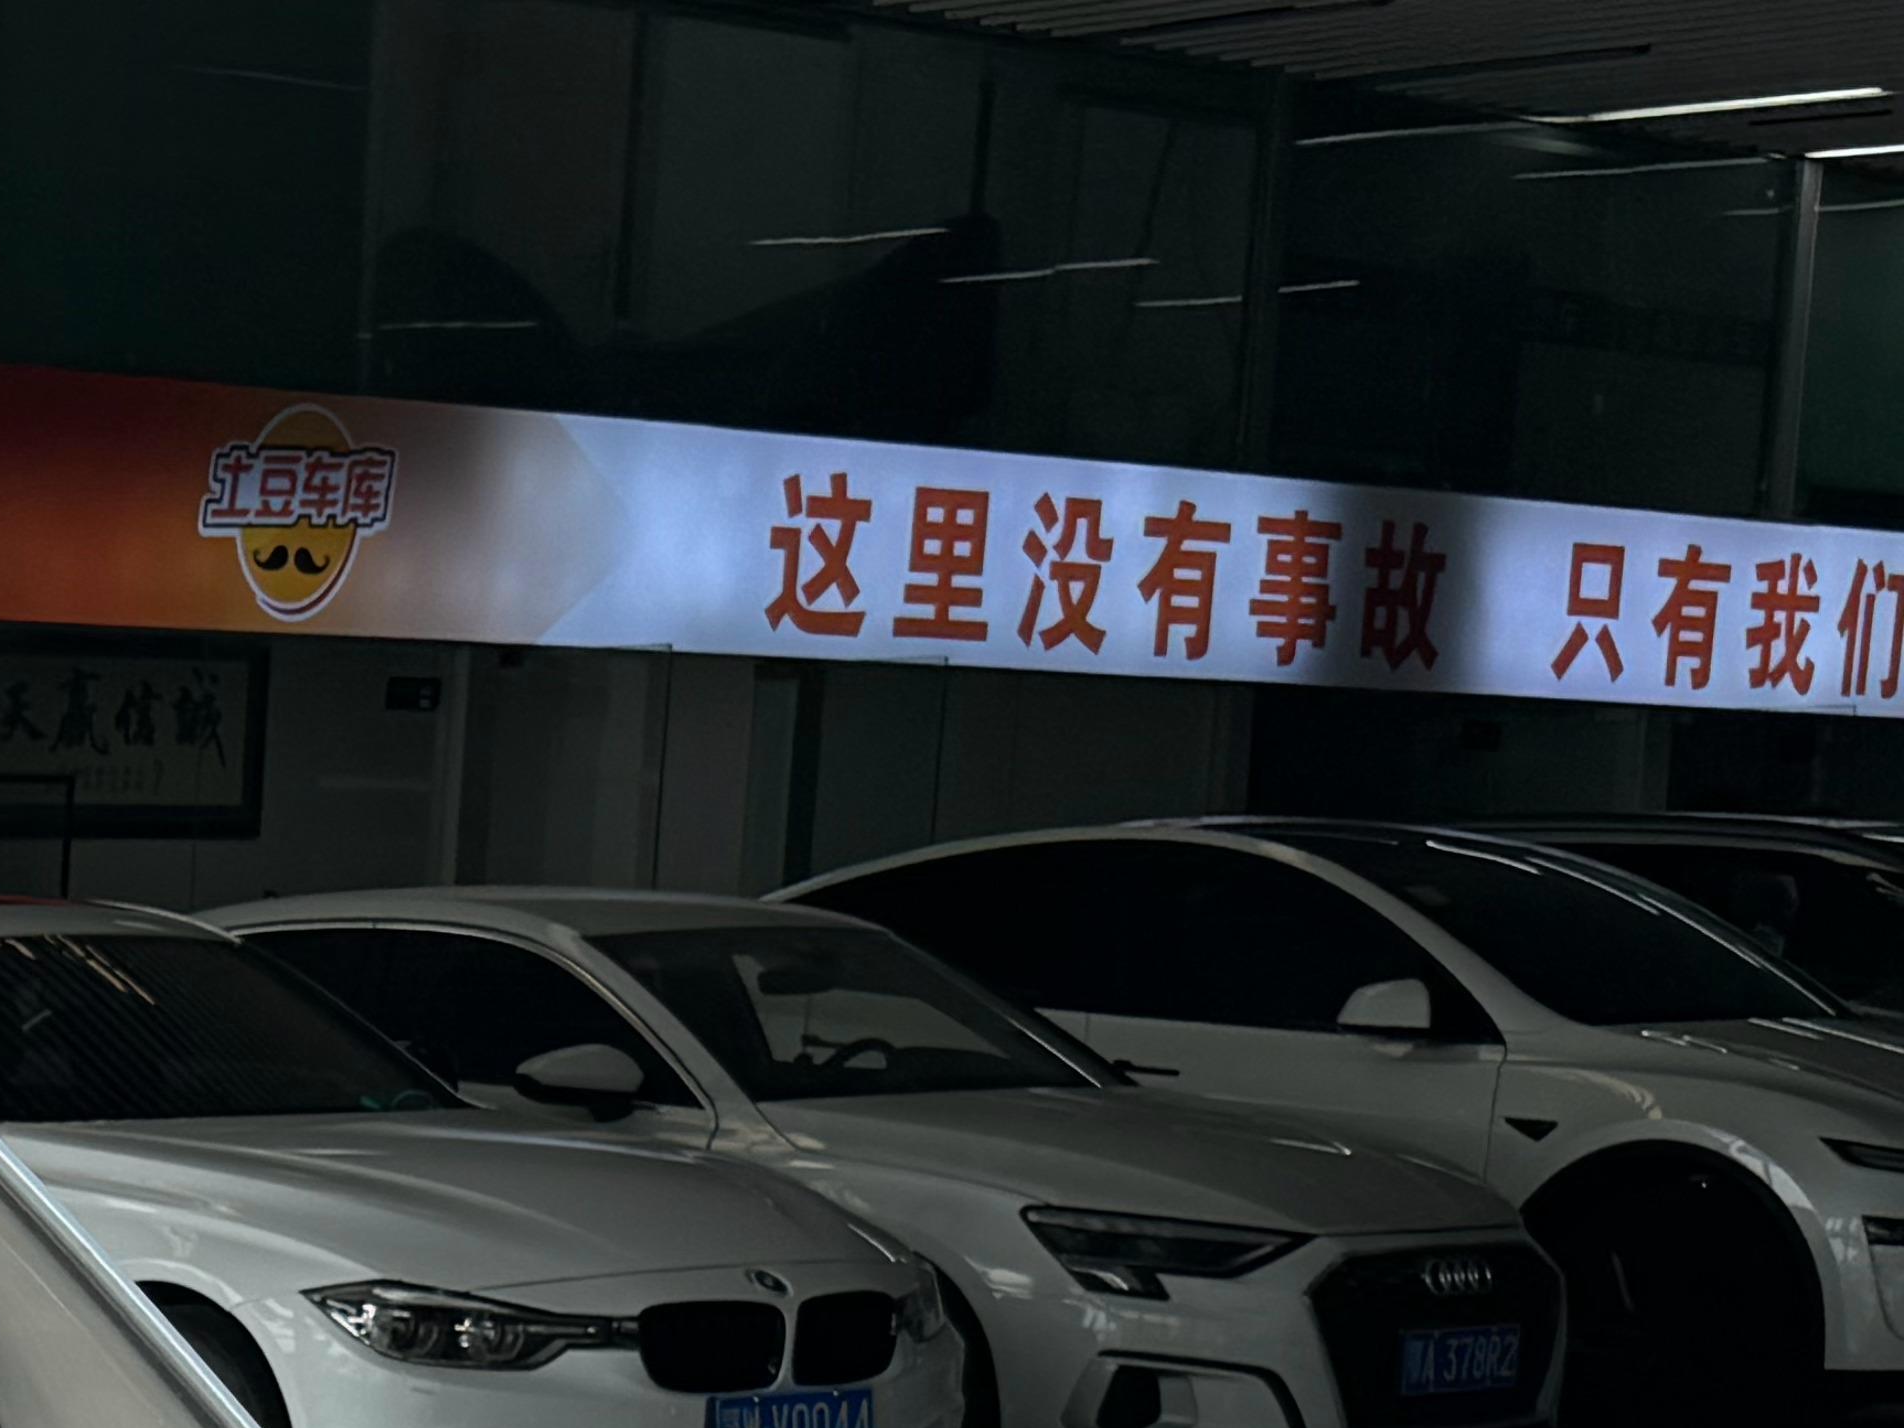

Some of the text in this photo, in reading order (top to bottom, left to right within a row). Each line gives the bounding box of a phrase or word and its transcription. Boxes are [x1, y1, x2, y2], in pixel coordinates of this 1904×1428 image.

[208, 450, 391, 522] 土豆车库
[764, 472, 1904, 699] 这里没有事故 只有我们
